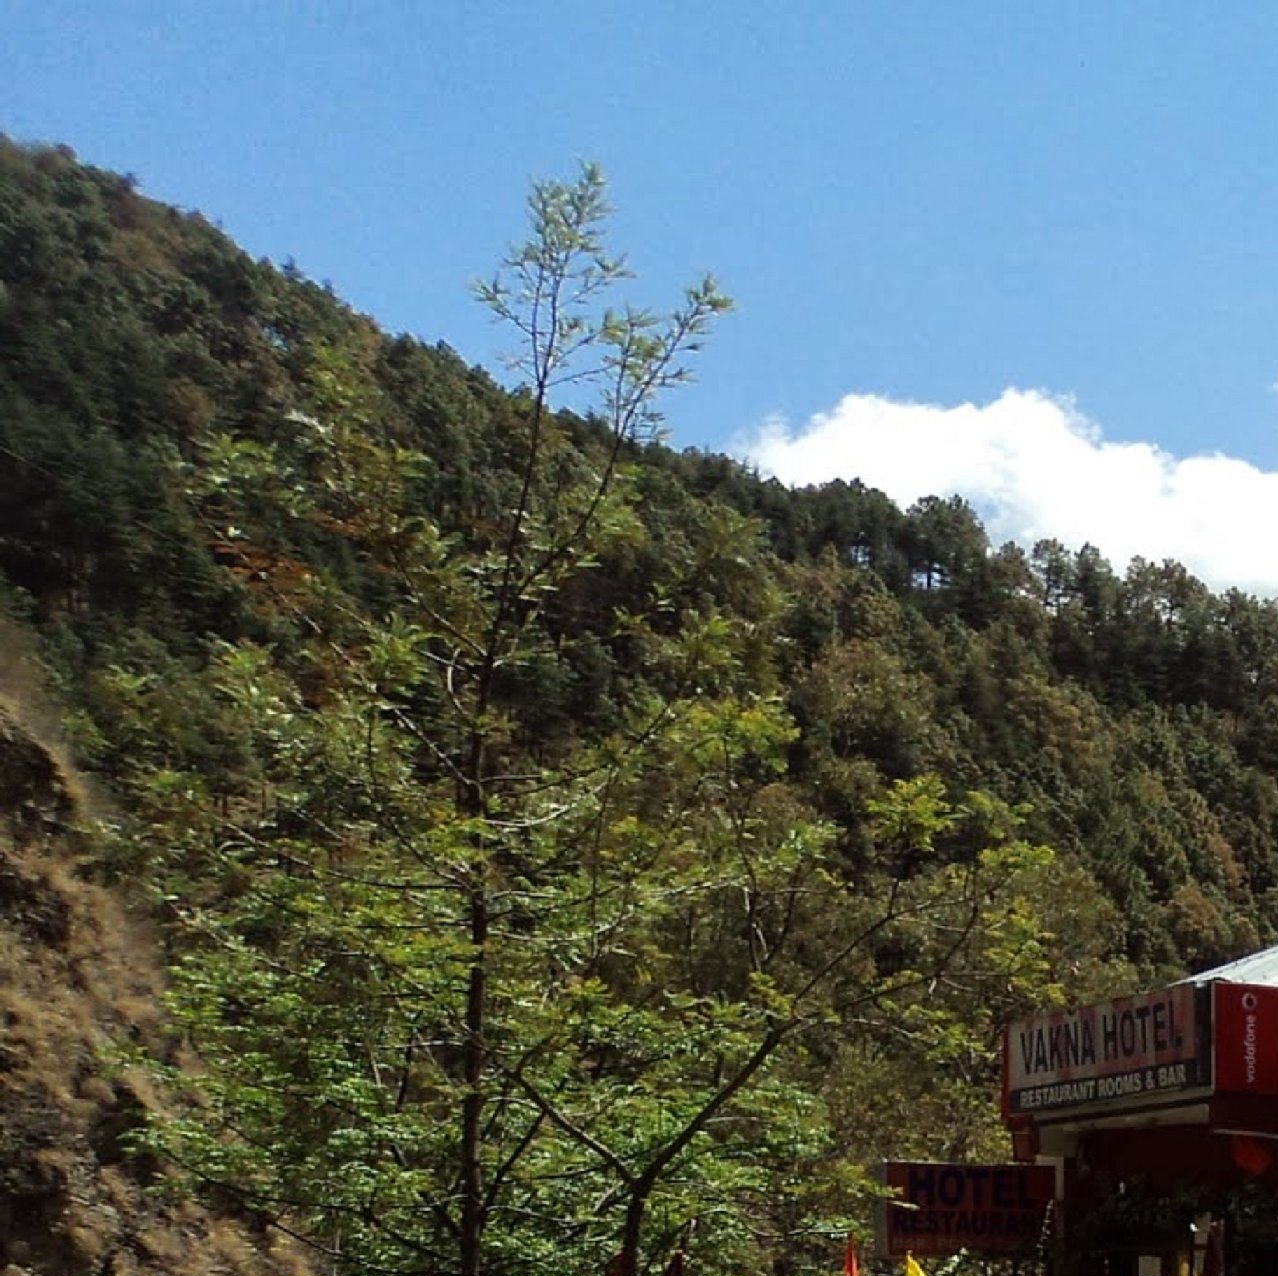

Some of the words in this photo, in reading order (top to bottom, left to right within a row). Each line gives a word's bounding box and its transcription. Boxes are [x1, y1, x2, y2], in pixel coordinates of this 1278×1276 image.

[1102, 1001, 1184, 1062] HOTEL
[1244, 1014, 1257, 1083] vodafone
[1020, 1081, 1096, 1108] RESTAURANT
[1100, 1073, 1142, 1098] ROOMS
[1146, 1066, 1154, 1089] &
[1157, 1063, 1187, 1086] BAR
[908, 1165, 1038, 1206] HOTEL
